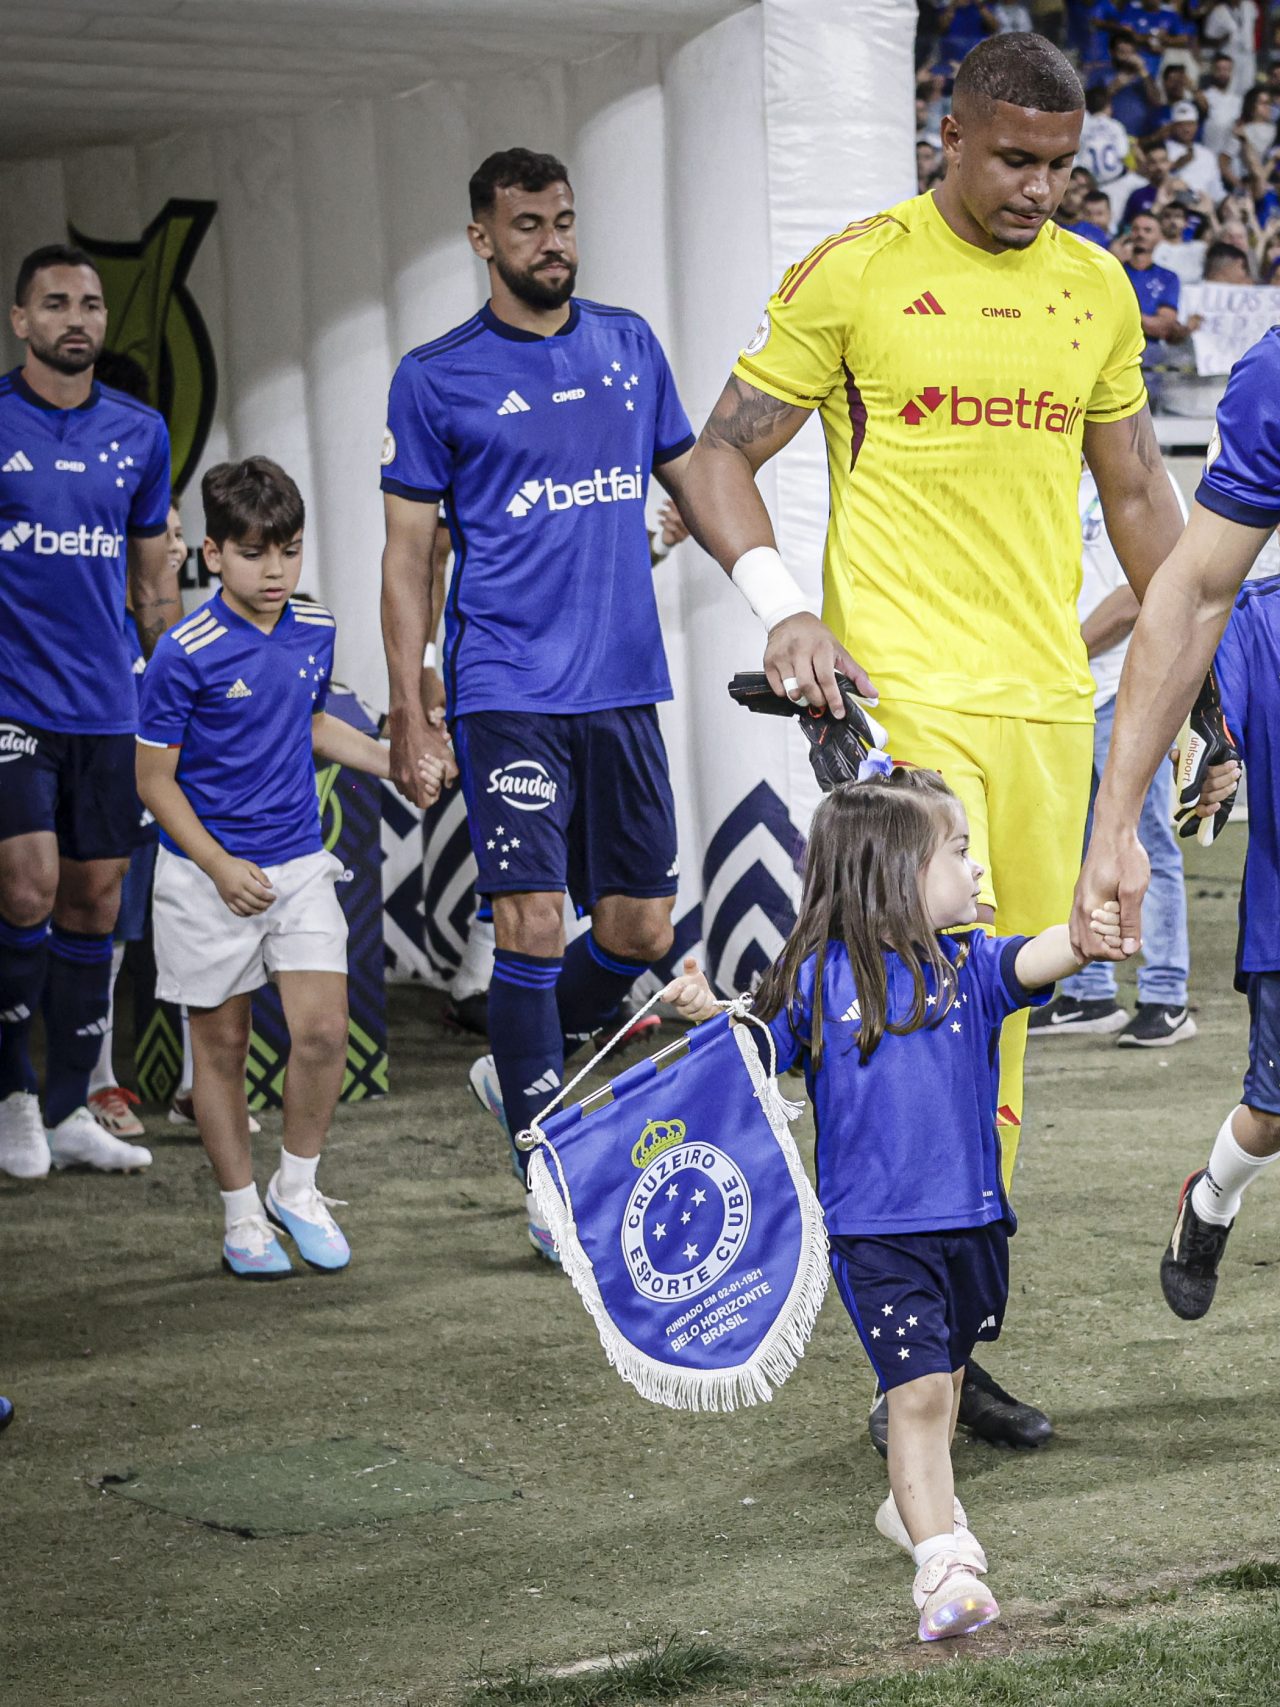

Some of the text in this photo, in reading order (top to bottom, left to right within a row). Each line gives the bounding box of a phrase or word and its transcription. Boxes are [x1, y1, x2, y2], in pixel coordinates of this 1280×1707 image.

[981, 307, 1022, 319] CIMED
[552, 388, 586, 403] CIMED
[951, 386, 1083, 435] betfair
[544, 465, 643, 511] betfai
[1182, 736, 1200, 782] uhlsport
[486, 767, 557, 803] Saudali
[628, 1149, 716, 1229] CRUZEIRO
[630, 1175, 745, 1296] ESPORTE CLUBE
[665, 1268, 763, 1337] FUNDADO EM 02-01-1921
[670, 1281, 772, 1353] BELO HORIZONTE
[700, 1313, 748, 1346] BRASIL
